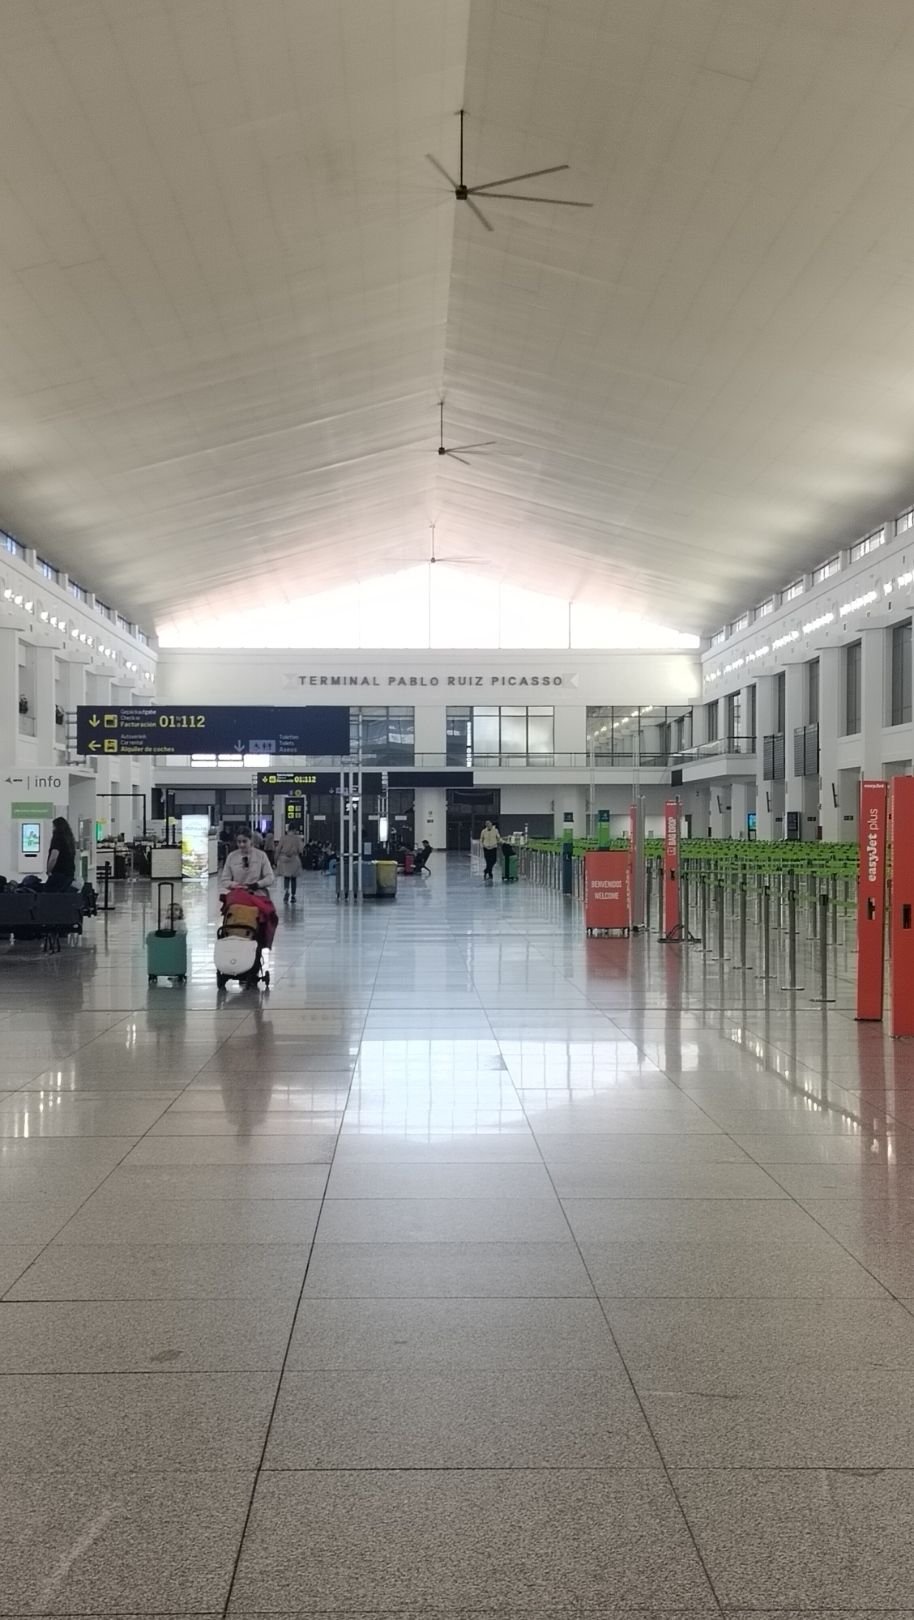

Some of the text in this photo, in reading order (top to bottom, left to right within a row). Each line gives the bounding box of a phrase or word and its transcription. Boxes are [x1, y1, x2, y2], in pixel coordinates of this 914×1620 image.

[299, 676, 562, 686] TERMINAL PABLO RUIZ PICASSO
[35, 776, 61, 788] info
[866, 808, 880, 882] easyJet plus
[594, 892, 619, 900] WELCOME
